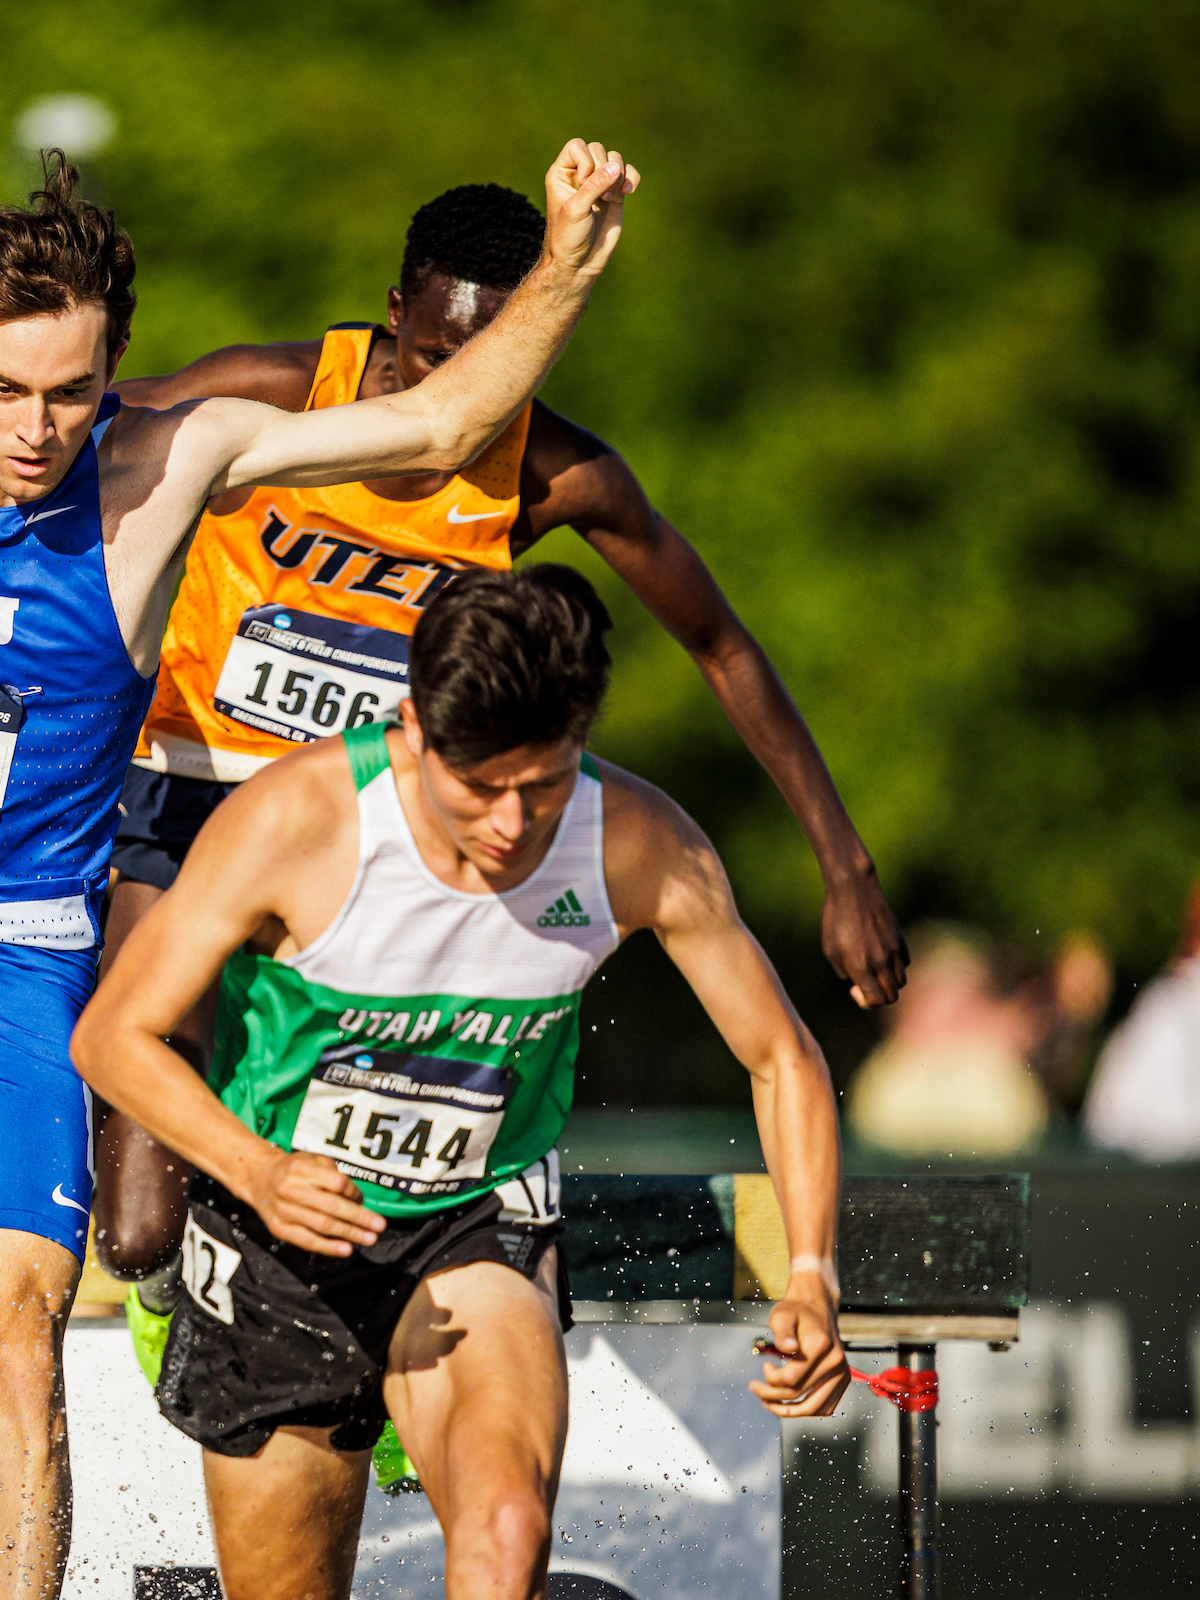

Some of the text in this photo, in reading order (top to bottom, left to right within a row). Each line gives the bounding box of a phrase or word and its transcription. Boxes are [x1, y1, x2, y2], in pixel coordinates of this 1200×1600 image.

[268, 632, 300, 650] TRACK
[306, 641, 333, 658] FIELD
[331, 648, 409, 676] CHAMPIONSHIPS
[245, 660, 380, 729] 1566
[230, 708, 307, 743] SACRAMENTO, CA
[537, 911, 591, 928] adidas
[338, 1008, 442, 1043] UTAH
[419, 1083, 505, 1108] CHAMPIONSHIPS
[325, 1103, 472, 1169] 1544
[379, 1174, 395, 1188] CA
